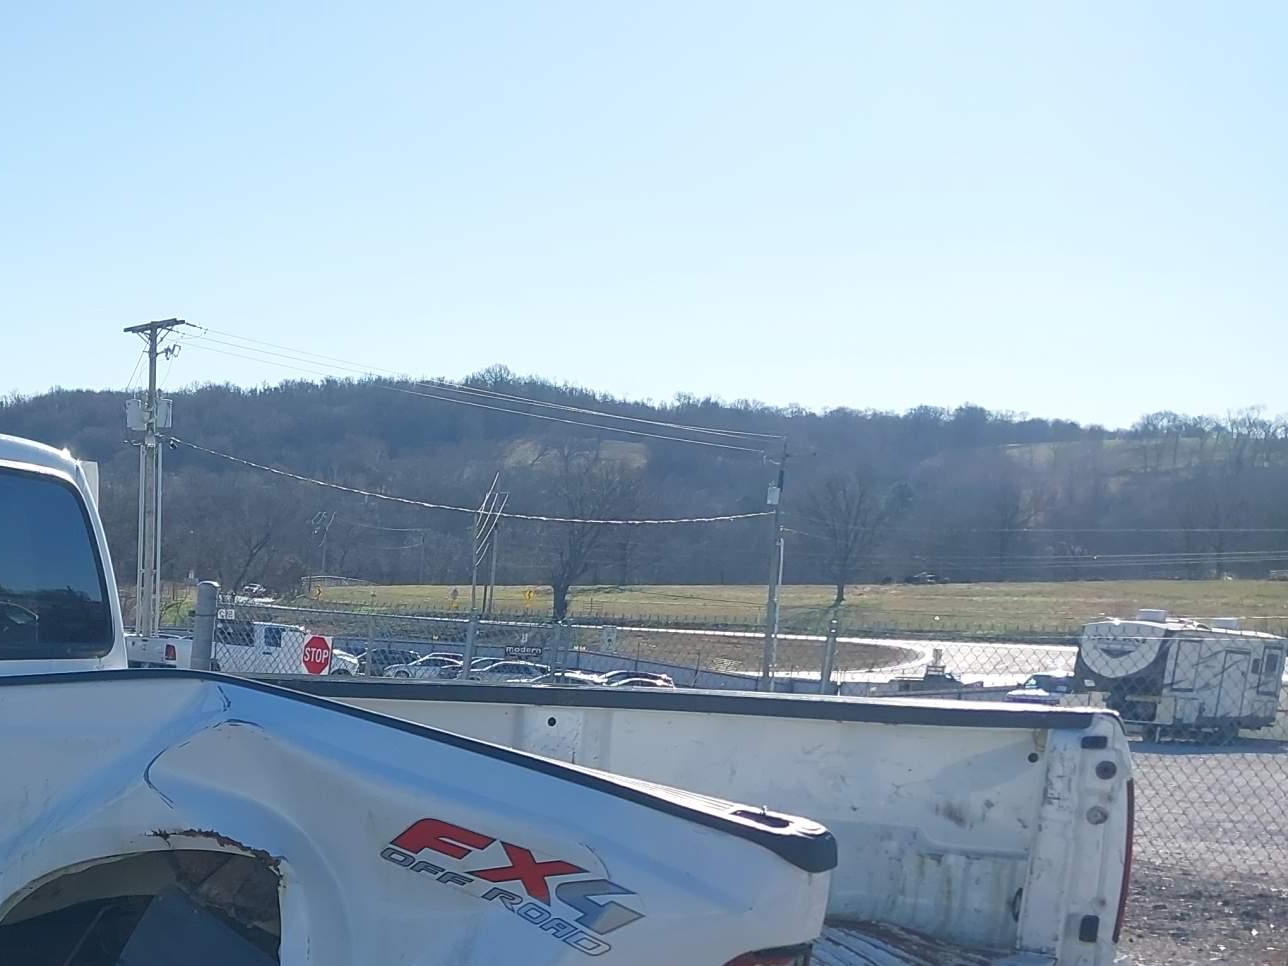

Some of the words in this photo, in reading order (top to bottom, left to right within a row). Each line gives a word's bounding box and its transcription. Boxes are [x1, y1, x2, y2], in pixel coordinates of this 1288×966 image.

[303, 647, 329, 664] STOP
[380, 847, 475, 887] OFF
[481, 887, 612, 957] ROAD
[389, 817, 647, 936] FX4
